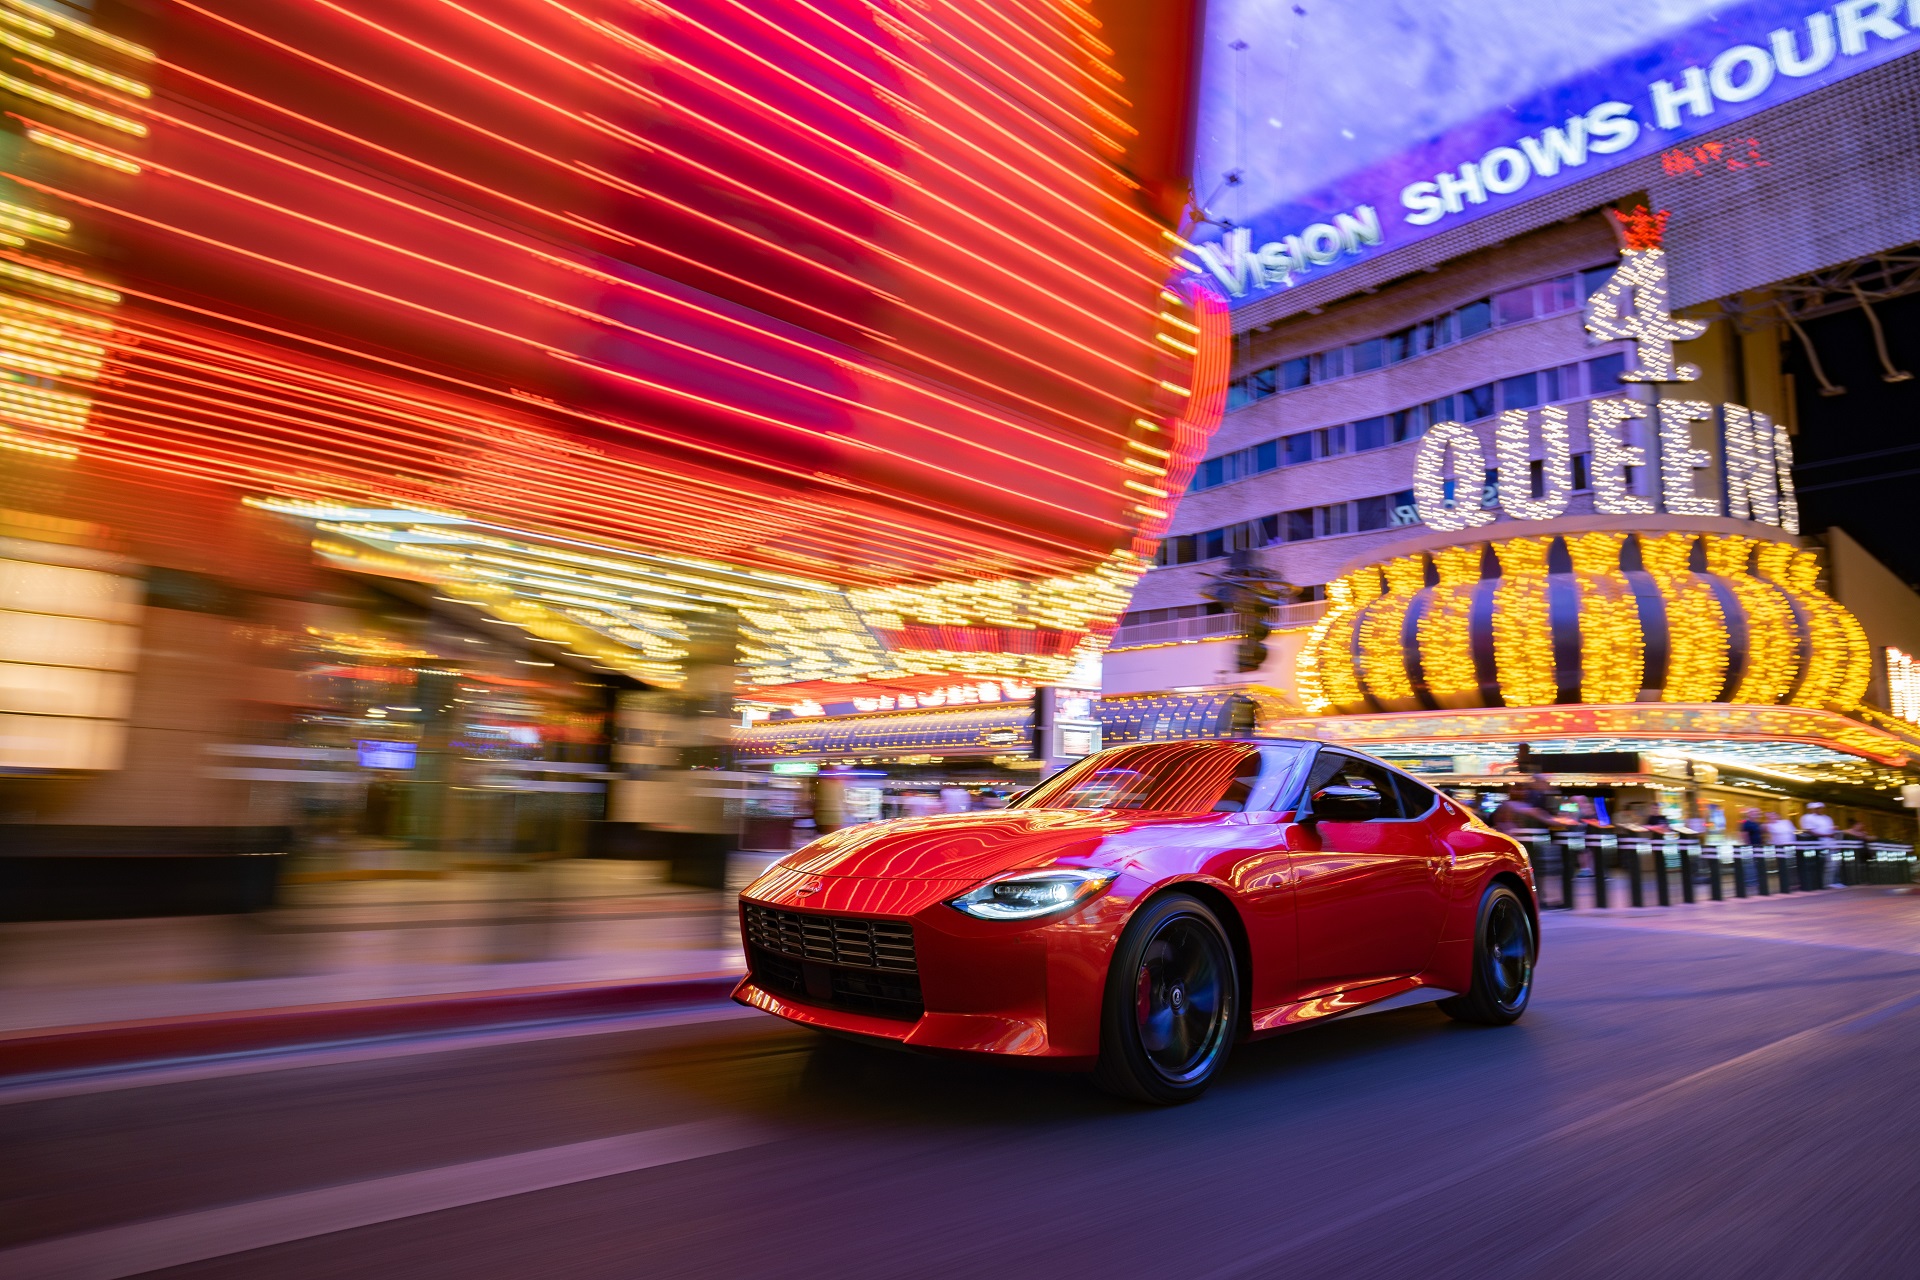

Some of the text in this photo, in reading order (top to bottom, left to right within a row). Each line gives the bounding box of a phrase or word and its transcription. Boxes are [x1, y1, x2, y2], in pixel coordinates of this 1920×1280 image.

[1403, 102, 1641, 226] SHOWS
[1650, 0, 1920, 130] HOUR
[1584, 248, 1708, 382] 4
